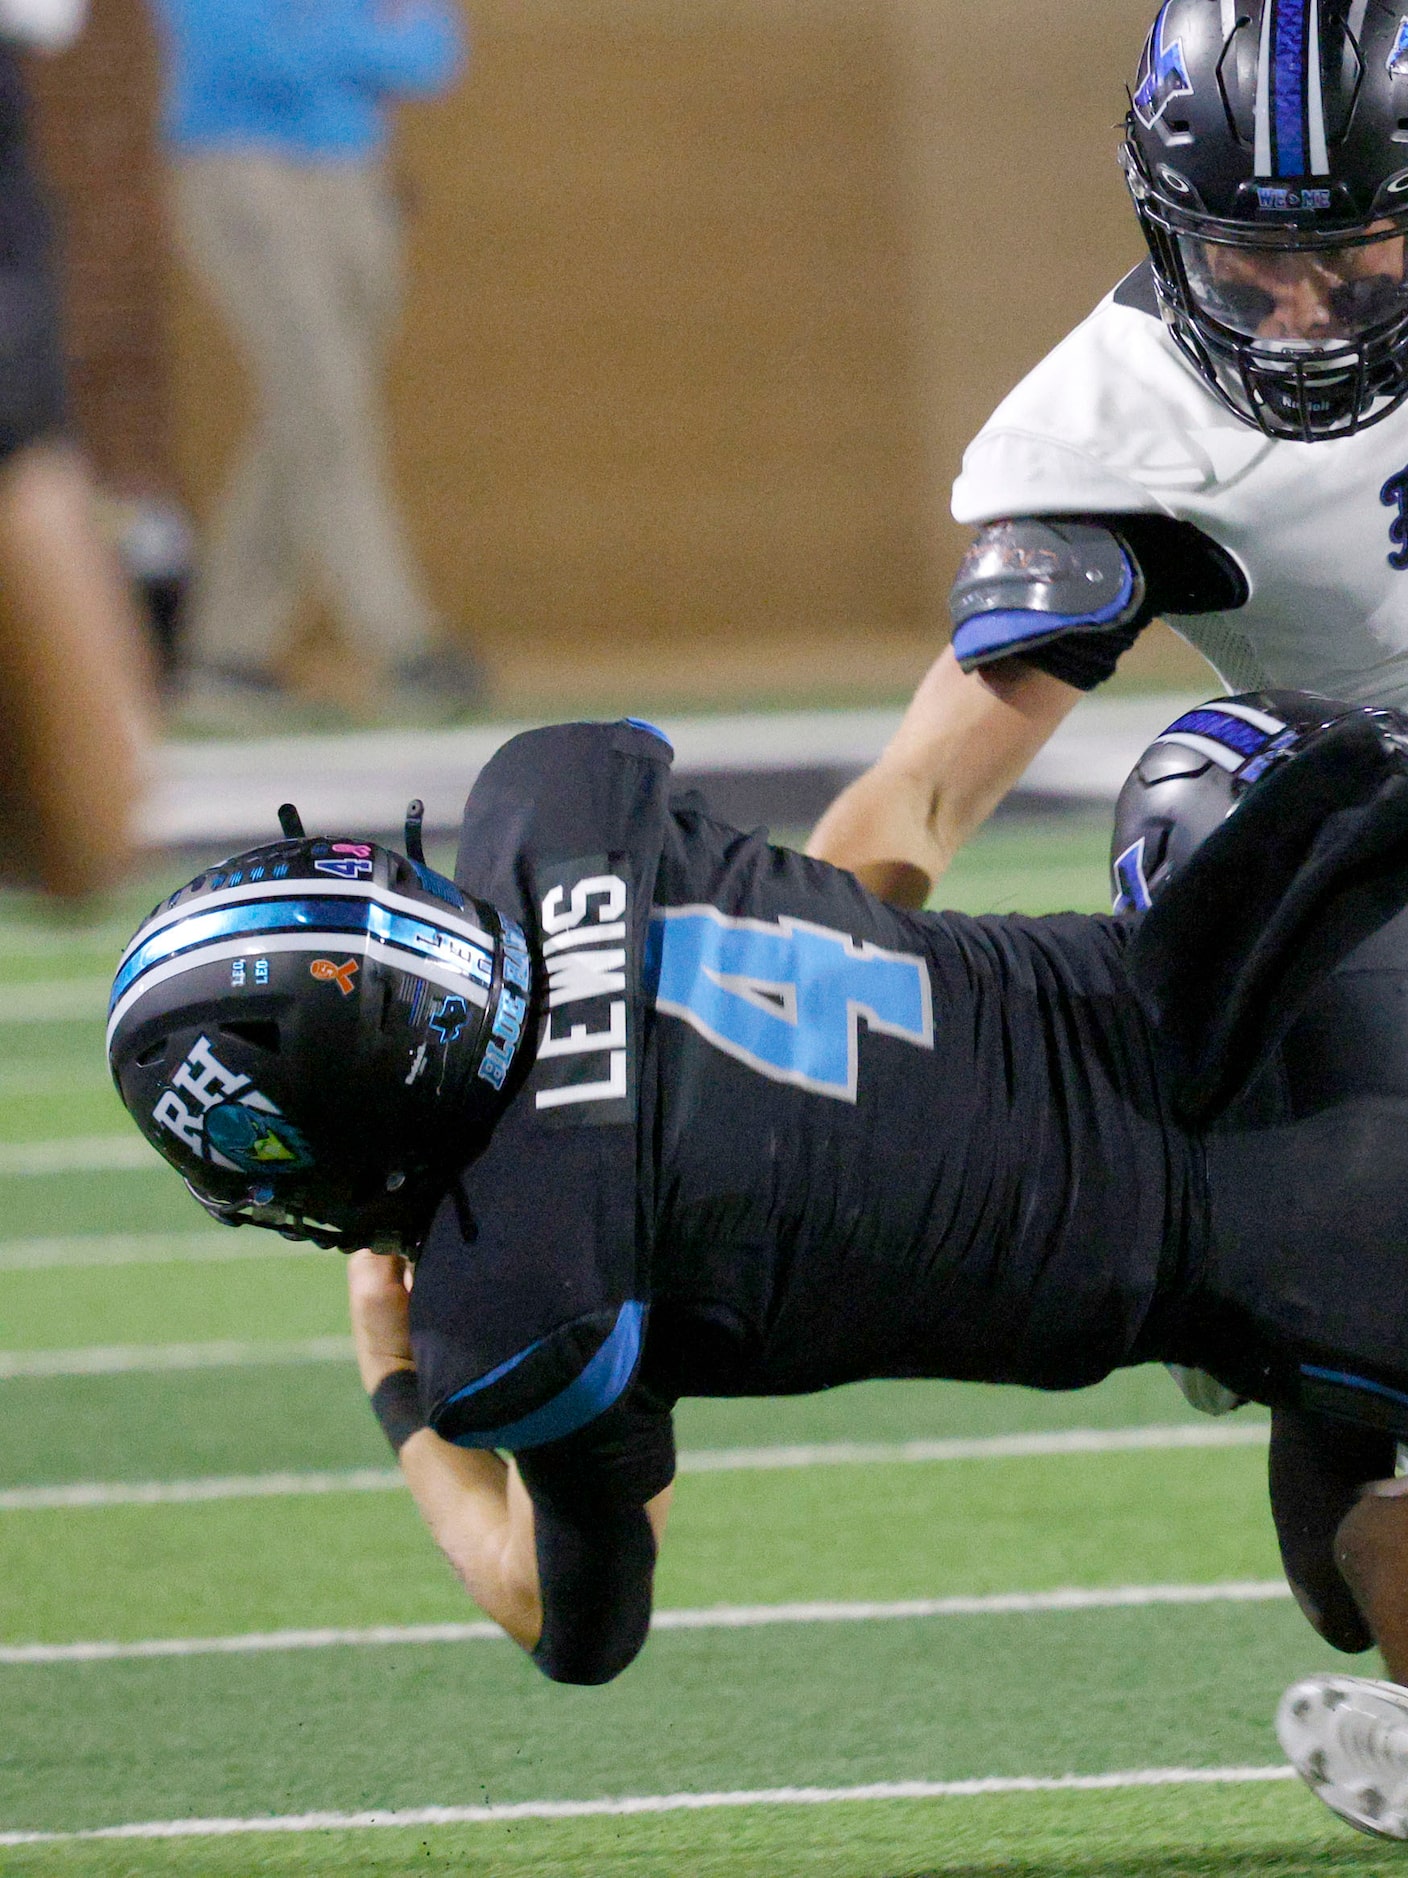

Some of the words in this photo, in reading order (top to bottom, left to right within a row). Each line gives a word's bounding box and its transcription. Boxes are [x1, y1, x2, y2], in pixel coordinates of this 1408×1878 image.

[314, 857, 373, 879] 4
[476, 989, 527, 1091] BLUE
[535, 874, 627, 1109] LEWIS
[645, 903, 934, 1104] 4
[152, 1034, 260, 1160] RH
